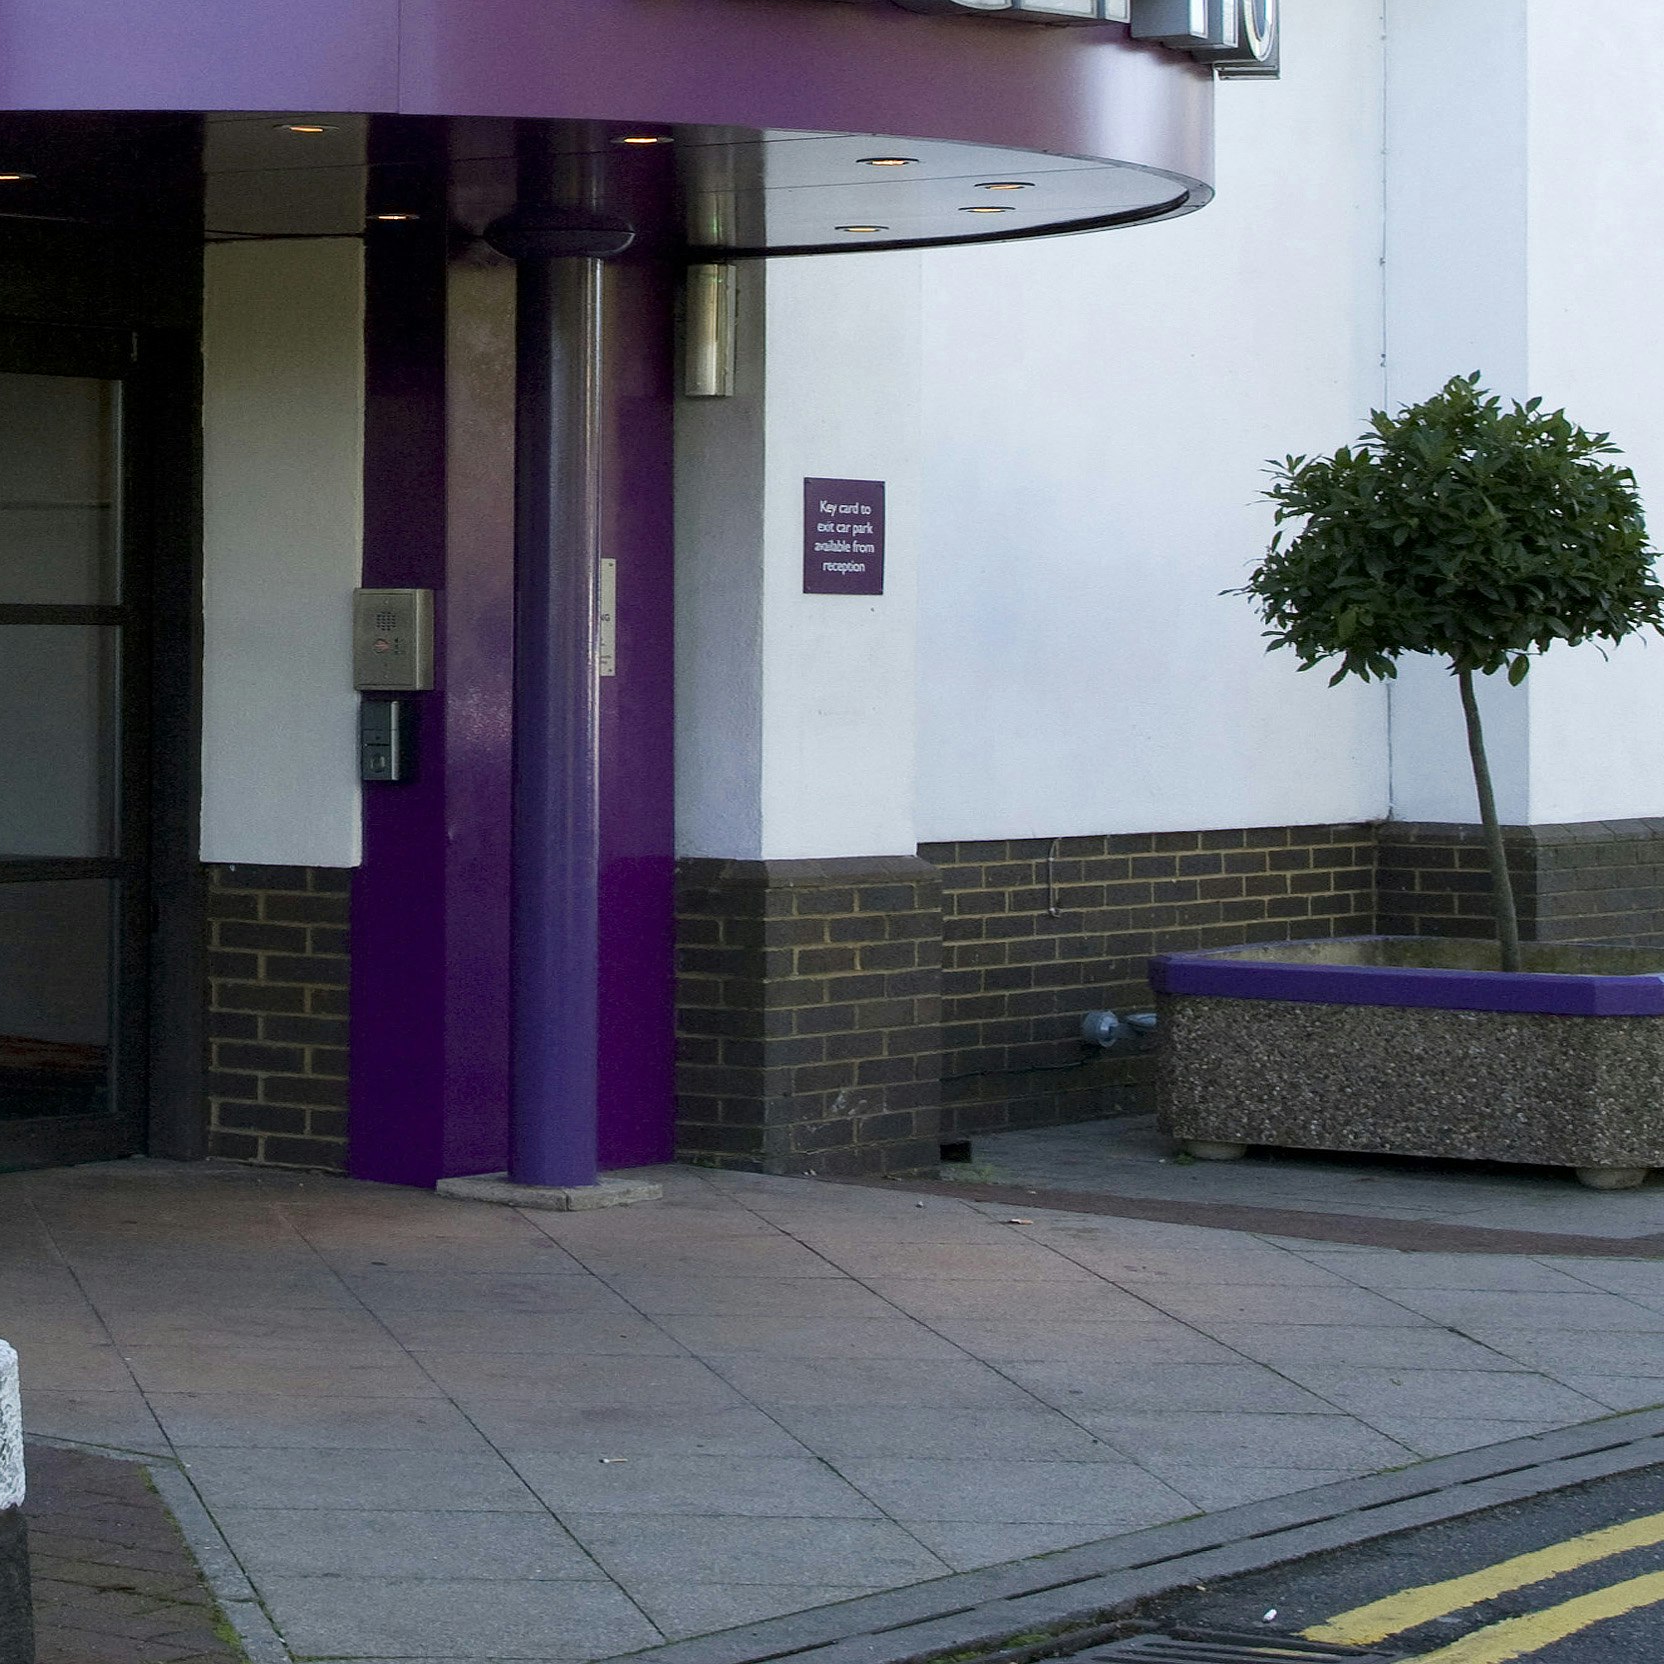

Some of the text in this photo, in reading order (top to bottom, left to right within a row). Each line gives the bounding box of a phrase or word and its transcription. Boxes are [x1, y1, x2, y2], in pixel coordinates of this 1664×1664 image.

[819, 500, 872, 517] Key card to
[817, 521, 874, 537] exit car park
[814, 539, 875, 554] available from
[822, 559, 866, 575] reception
